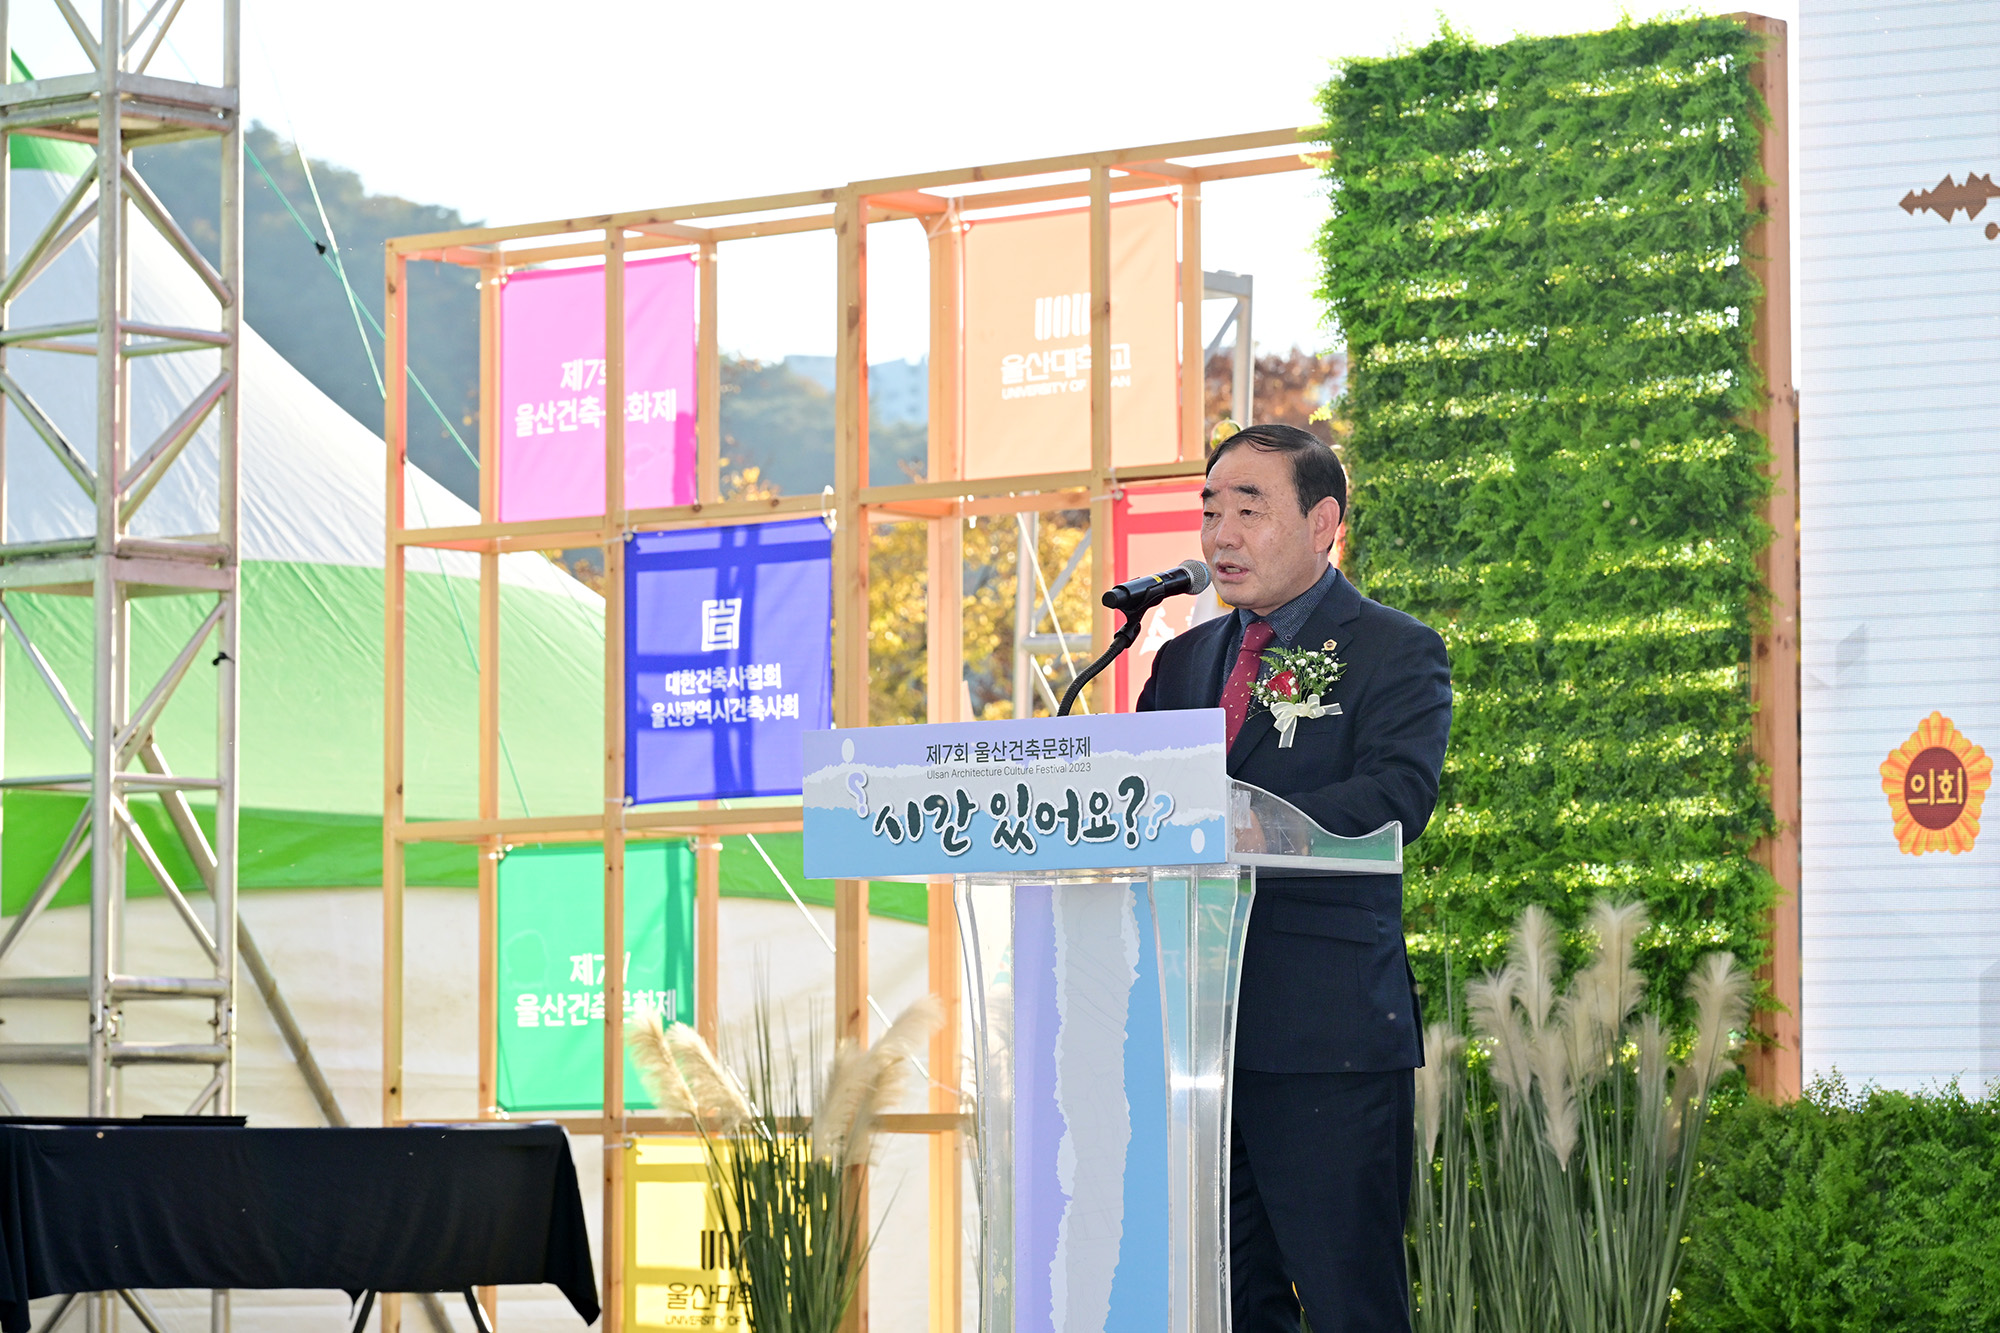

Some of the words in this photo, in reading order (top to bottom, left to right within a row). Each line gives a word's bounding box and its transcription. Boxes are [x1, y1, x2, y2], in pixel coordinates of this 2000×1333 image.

[515, 388, 677, 438] 울산건축화제
[665, 662, 782, 696] 대한건축사협회
[651, 692, 799, 729] 울산광역시건축사회
[926, 742, 969, 765] 제7회
[974, 736, 1092, 763] 울산건축문화제
[926, 769, 950, 780] Ulsan
[951, 766, 1003, 778] Architecture
[1003, 764, 1035, 776] Culture
[1036, 762, 1067, 774] Festival
[1068, 762, 1092, 773] 2023
[1907, 766, 1964, 805] 의회
[874, 787, 977, 853] 시간
[989, 775, 1147, 852] 있어요?
